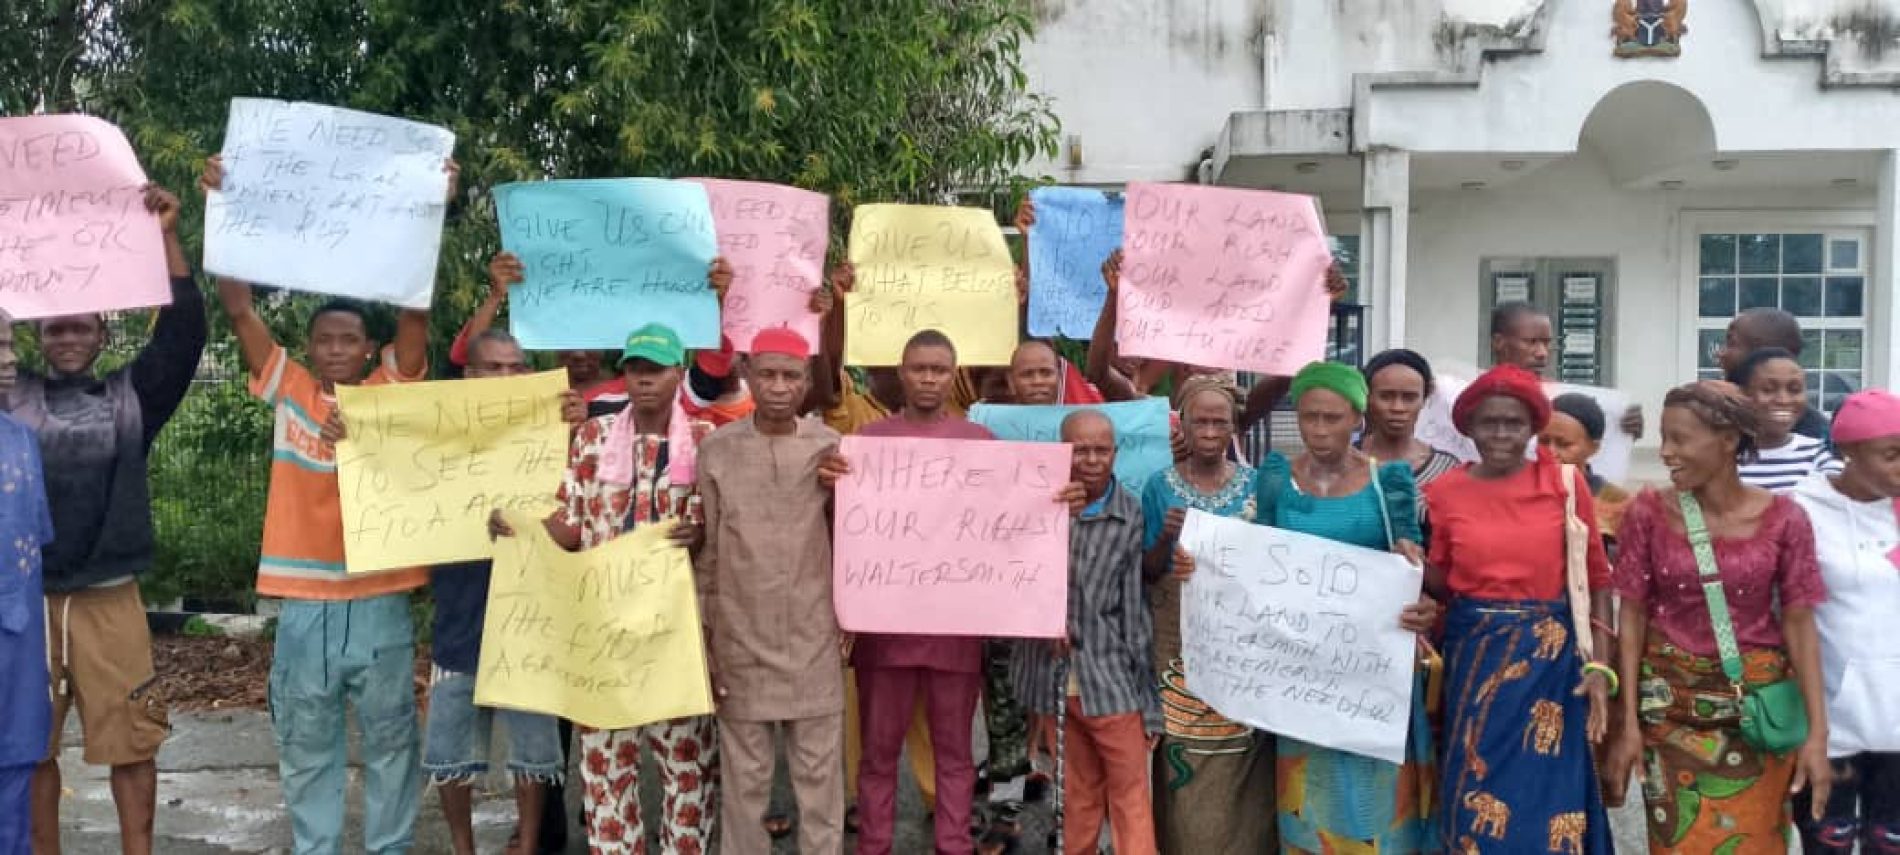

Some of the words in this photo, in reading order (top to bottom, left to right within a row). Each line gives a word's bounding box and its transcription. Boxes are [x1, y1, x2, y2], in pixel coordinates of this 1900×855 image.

[308, 119, 388, 150] NEED
[592, 197, 650, 249] US
[1134, 189, 1202, 230] OUR
[1223, 204, 1309, 235] LAND
[936, 220, 992, 261] US
[519, 281, 567, 308] WE
[570, 275, 631, 299] ARE
[857, 262, 931, 299] WHAT
[1128, 262, 1185, 290] OUR
[847, 297, 882, 333] TO
[890, 300, 946, 329] US
[344, 394, 413, 448] WE
[433, 393, 551, 438] NEED
[341, 451, 391, 504] TO
[408, 441, 499, 493] SEE
[511, 438, 564, 476] THE
[853, 443, 994, 494] WHERE
[1010, 459, 1053, 489] IS
[842, 502, 929, 543] OUR
[845, 556, 1047, 593] WALTERSMITH
[494, 591, 557, 639] THE
[1236, 588, 1310, 635] LAND
[1316, 608, 1358, 645] TO
[1329, 645, 1393, 675] WITH
